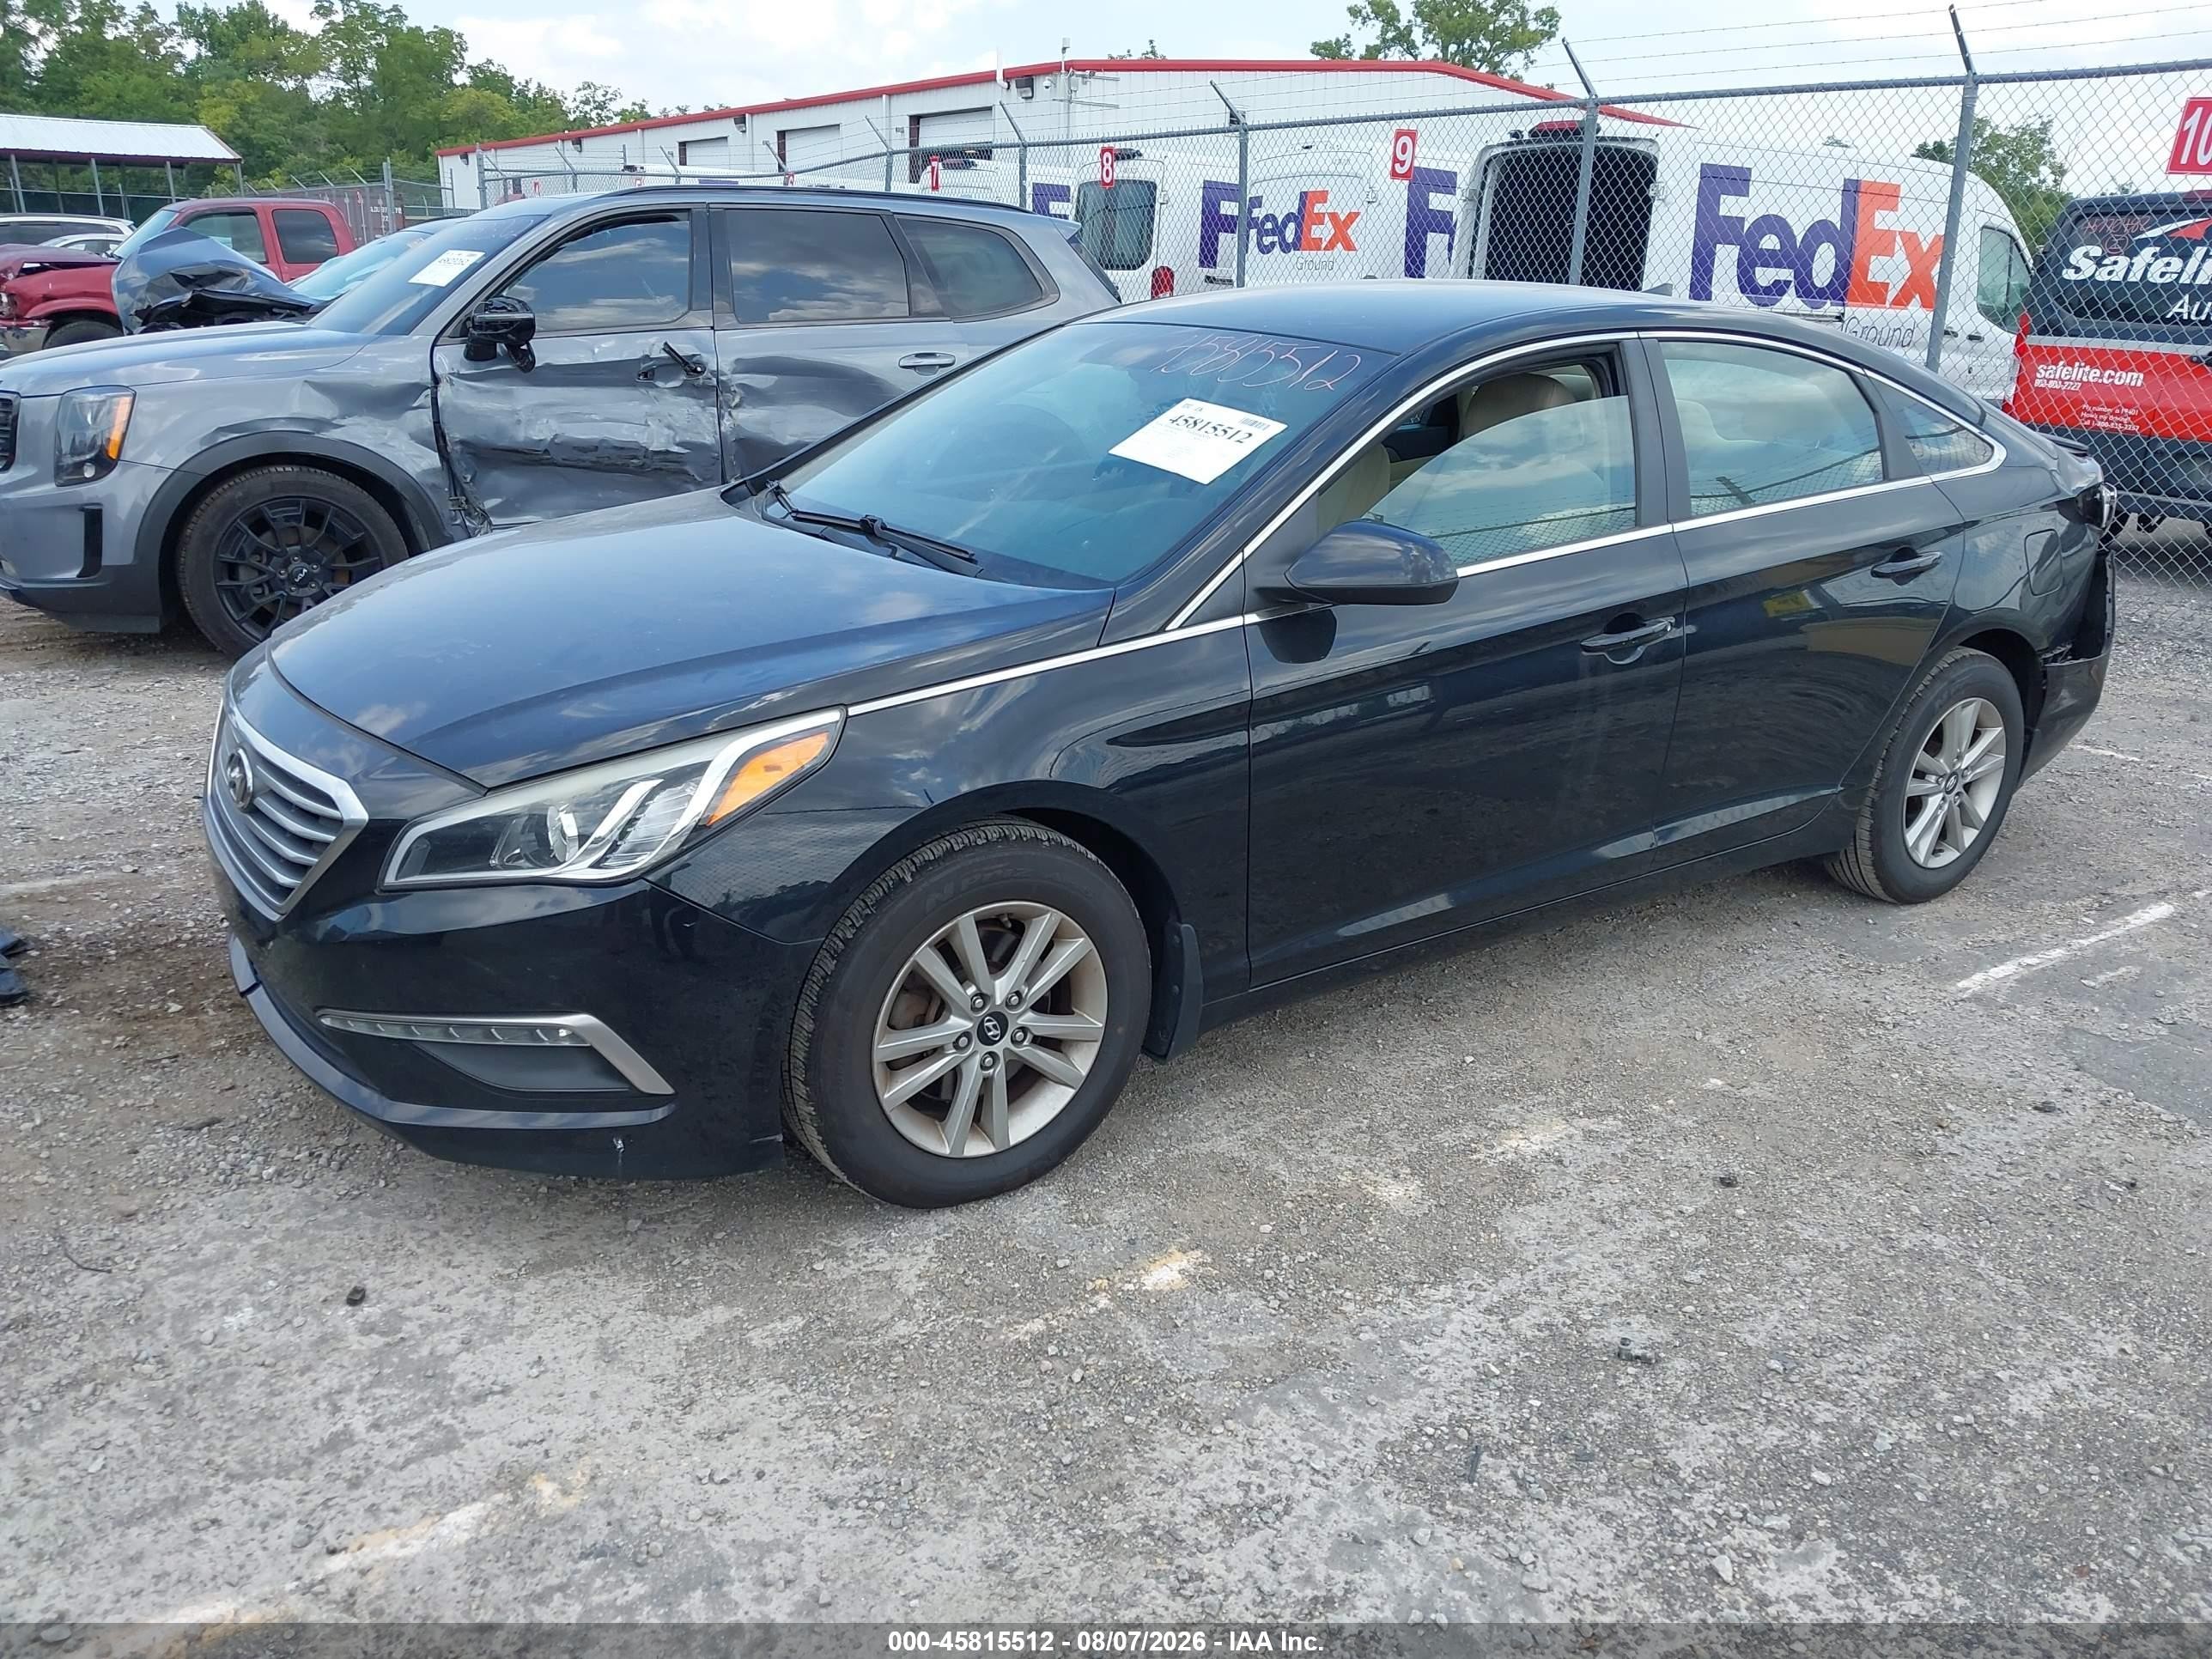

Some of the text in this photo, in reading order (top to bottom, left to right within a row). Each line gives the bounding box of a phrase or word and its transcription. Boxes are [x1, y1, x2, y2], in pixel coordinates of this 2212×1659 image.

[1103, 152, 1113, 184] 8
[1394, 136, 1413, 174] 9
[931, 161, 938, 187] 7
[1245, 190, 1361, 255] FedEx
[1688, 162, 1945, 311] FedEx
[1296, 257, 1335, 271] Ground
[1845, 316, 1917, 348] Ground
[2036, 361, 2144, 387] safelite.com
[1170, 413, 1253, 444] 45815512
